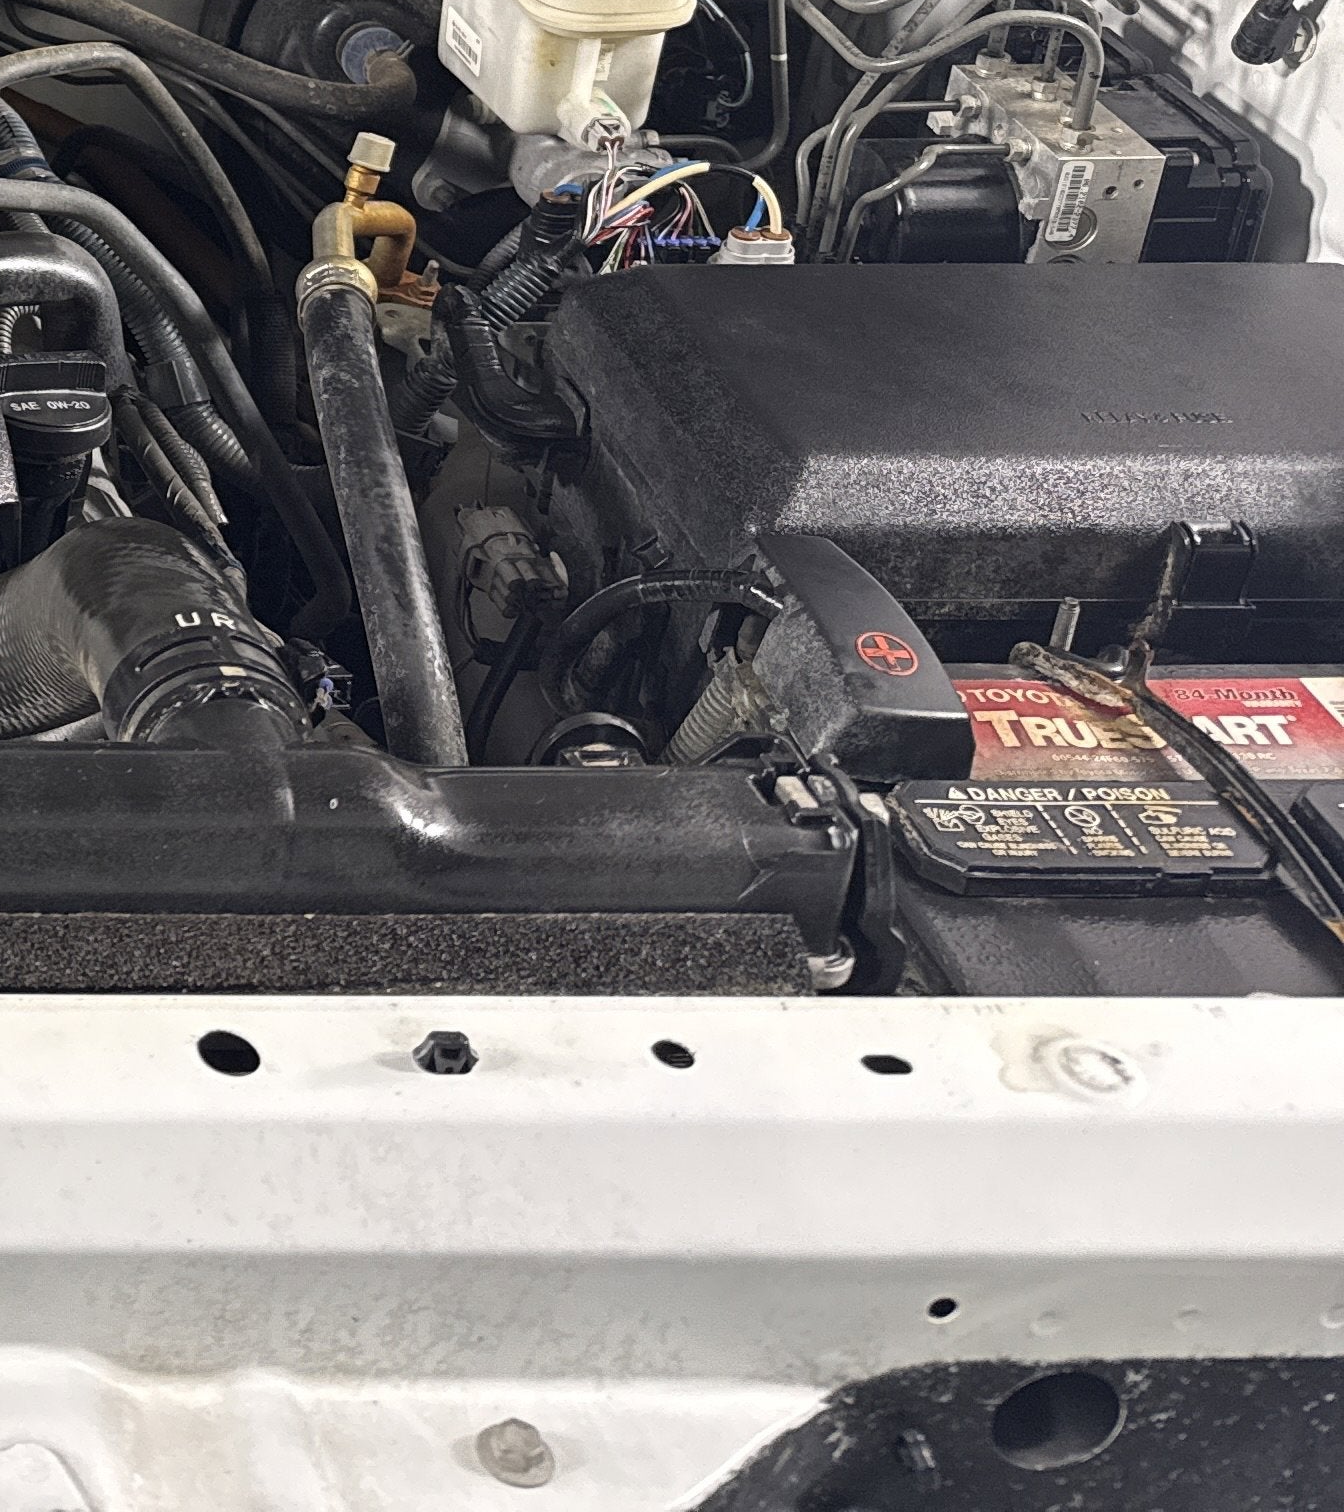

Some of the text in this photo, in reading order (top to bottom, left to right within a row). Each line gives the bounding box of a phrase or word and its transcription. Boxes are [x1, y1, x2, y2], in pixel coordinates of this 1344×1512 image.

[9, 401, 42, 412] SAE
[966, 787, 1063, 801] DANGER
[1080, 787, 1171, 801] POISON
[989, 809, 1034, 819] SHIELD
[995, 817, 1030, 827] EYES
